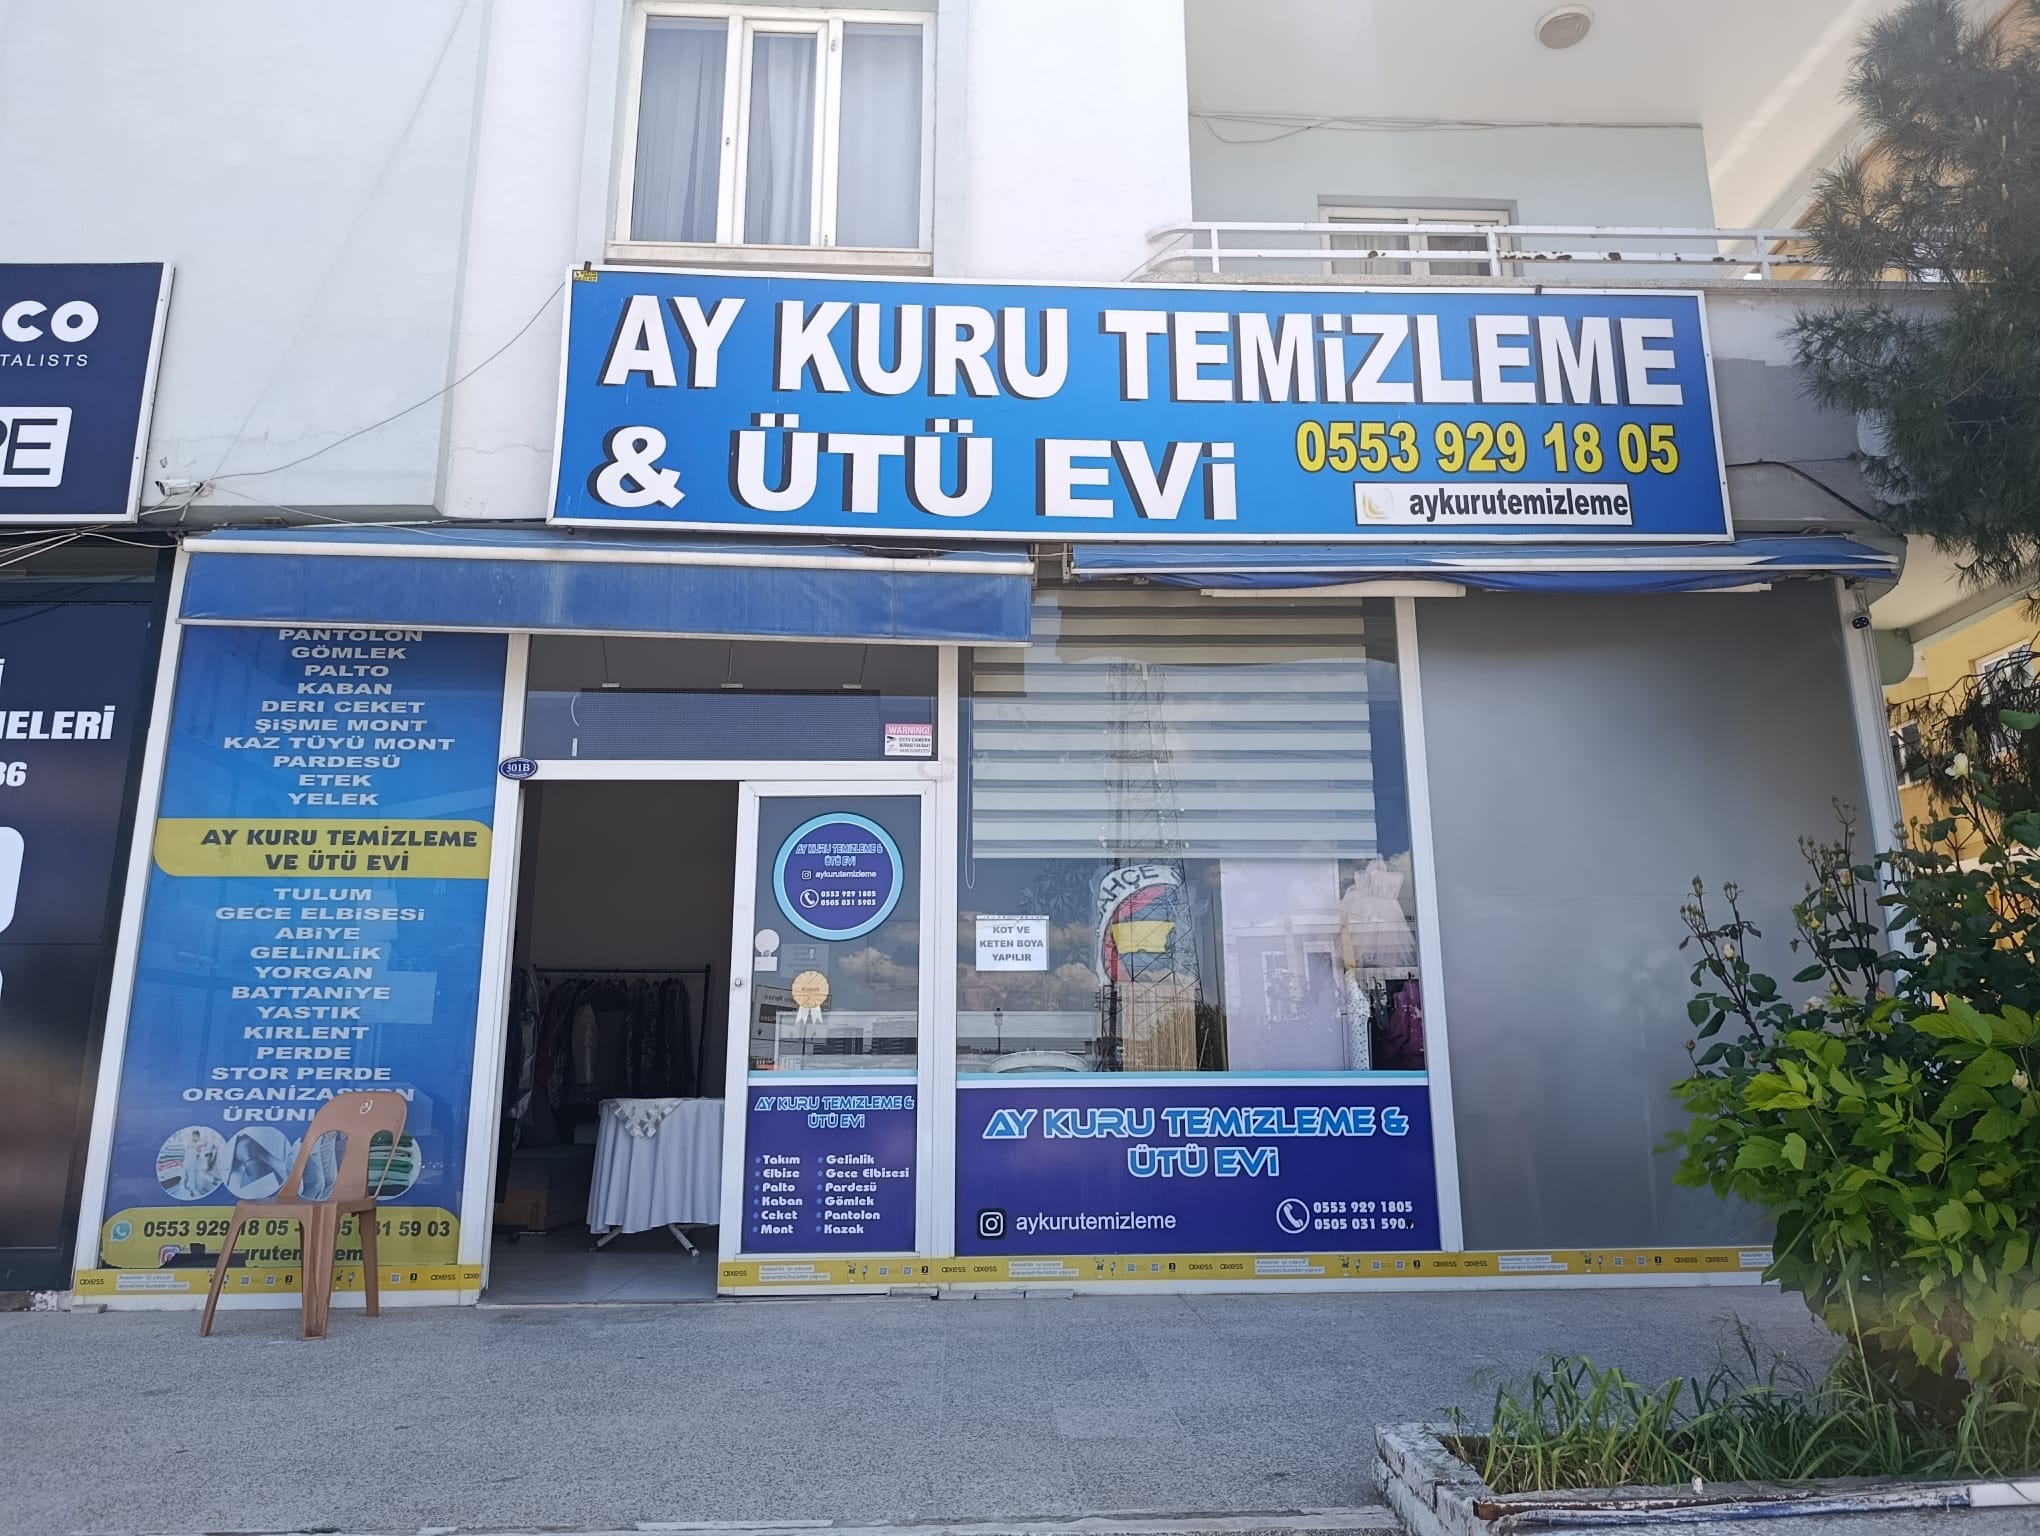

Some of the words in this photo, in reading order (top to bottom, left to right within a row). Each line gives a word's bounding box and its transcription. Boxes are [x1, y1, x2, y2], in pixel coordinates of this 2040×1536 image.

[597, 294, 746, 388] AY
[774, 299, 1068, 400] KURU
[1296, 421, 1420, 474] 0553
[1434, 421, 1527, 474] 929
[1543, 421, 1604, 474] 18
[1617, 422, 1680, 475] 05
[588, 425, 685, 509] &
[728, 412, 993, 517] ÜTÜ
[1410, 488, 1629, 522] aykurutemizleme
[278, 629, 423, 642] PANTOLON
[291, 645, 407, 660] GÖMLEK
[304, 665, 390, 677] PALTO
[297, 683, 392, 695] KABAN
[334, 701, 425, 714] CEKET
[347, 720, 427, 732] MONT
[888, 726, 930, 735] WARNING!
[224, 737, 280, 749] KAZ
[289, 735, 364, 749] TÜYÜ
[374, 739, 455, 751] MONT
[273, 753, 401, 768] PARDESÜ
[505, 763, 531, 772] 301B
[299, 775, 372, 787] ETEK
[288, 793, 379, 806] YELEK
[201, 830, 239, 845] AY
[247, 830, 318, 846] KURU
[327, 825, 478, 847] TEMİZLEME
[795, 844, 808, 854] AY
[265, 854, 298, 870] VE
[308, 850, 357, 871] ÜTÜ
[366, 851, 409, 871] EVİ
[815, 870, 877, 879] aykurutemizleme
[274, 888, 372, 901] TULUM
[215, 908, 291, 920] GECE
[992, 926, 1014, 934] KOT
[1016, 926, 1030, 934] VE
[980, 940, 1014, 948] KETEN
[992, 953, 1032, 961] YAPILIR
[254, 966, 373, 979] YORGAN
[256, 1006, 361, 1019] YASTIK
[243, 1027, 369, 1039] KIRLENT
[256, 1047, 351, 1060] PERDE
[211, 1068, 288, 1080] STOR
[297, 1068, 392, 1081] PERDE
[754, 1097, 776, 1111] AY
[776, 1096, 820, 1111] KURU
[903, 1095, 915, 1110] &
[807, 1113, 839, 1128] ÜTÜ
[983, 1109, 1037, 1140] AY
[1043, 1108, 1155, 1139] KURU
[1381, 1106, 1408, 1136] &
[762, 1154, 800, 1165] Takım
[826, 1154, 875, 1165] Gelinlik
[1127, 1143, 1209, 1178] ÜTÜ
[762, 1168, 800, 1178] Elbise
[825, 1168, 858, 1178] Gece
[862, 1168, 910, 1178] Elbisesi
[762, 1182, 796, 1192] Palto
[825, 1181, 877, 1192] Pardesü
[762, 1196, 803, 1206] Kaban
[825, 1195, 875, 1206] Gömlek
[1313, 1201, 1347, 1213] 0553
[1350, 1201, 1376, 1213] 929
[1380, 1201, 1413, 1213] 1805
[761, 1210, 798, 1220] Ceket
[824, 1210, 881, 1220] Pantolon
[144, 1221, 190, 1237] 0553
[196, 1220, 230, 1237] 929
[265, 1220, 289, 1236] 05
[1015, 1212, 1177, 1233] aykurutemizleme
[1314, 1218, 1348, 1230] 0505
[1351, 1218, 1376, 1230] 031
[1381, 1218, 1414, 1230] 590
[399, 1221, 422, 1237] 59
[428, 1221, 450, 1237] 03
[760, 1224, 794, 1234] Mont
[824, 1224, 864, 1234] Kazak
[1433, 1260, 1458, 1268] axess
[1674, 1256, 1698, 1264] axess
[1705, 1255, 1729, 1263] axess
[973, 1265, 998, 1273] axess
[1188, 1263, 1213, 1271] axess
[1219, 1262, 1244, 1270] axess
[80, 1278, 105, 1286] axess
[430, 1273, 456, 1281] axess
[464, 1272, 480, 1280] axe
